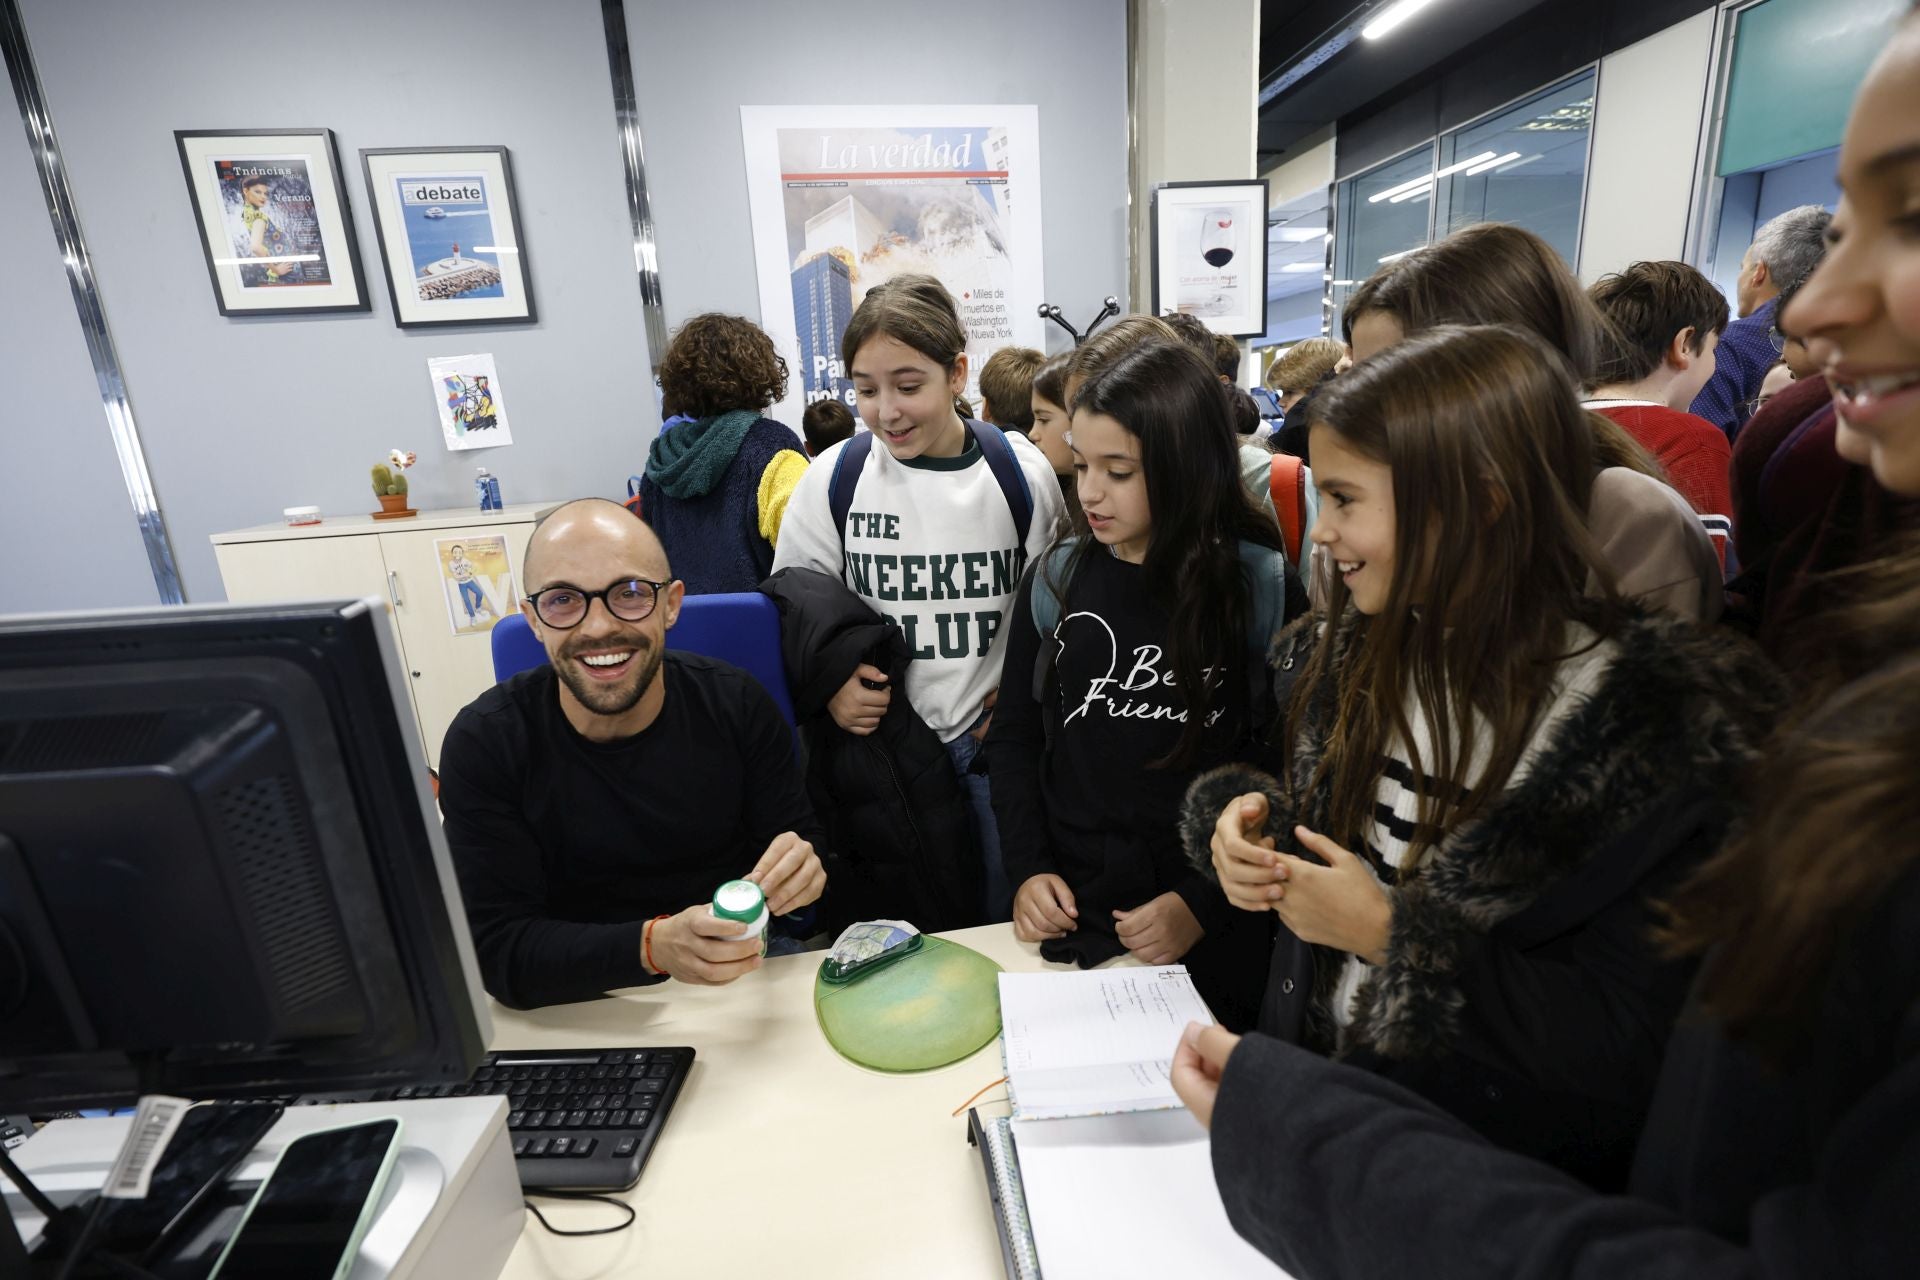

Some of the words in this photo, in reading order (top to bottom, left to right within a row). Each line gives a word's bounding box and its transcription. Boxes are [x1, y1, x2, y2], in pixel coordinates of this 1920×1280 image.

[818, 135, 859, 169] La
[869, 133, 973, 169] verdad
[232, 166, 292, 176] Tndncias
[273, 194, 311, 202] Verano
[973, 288, 993, 299] Miles
[995, 288, 1004, 299] de
[964, 303, 995, 314] muertos
[996, 304, 1005, 312] en
[965, 316, 1008, 328] Washington
[971, 329, 995, 340] Nueva
[997, 327, 1013, 338] York
[850, 512, 900, 540] THE
